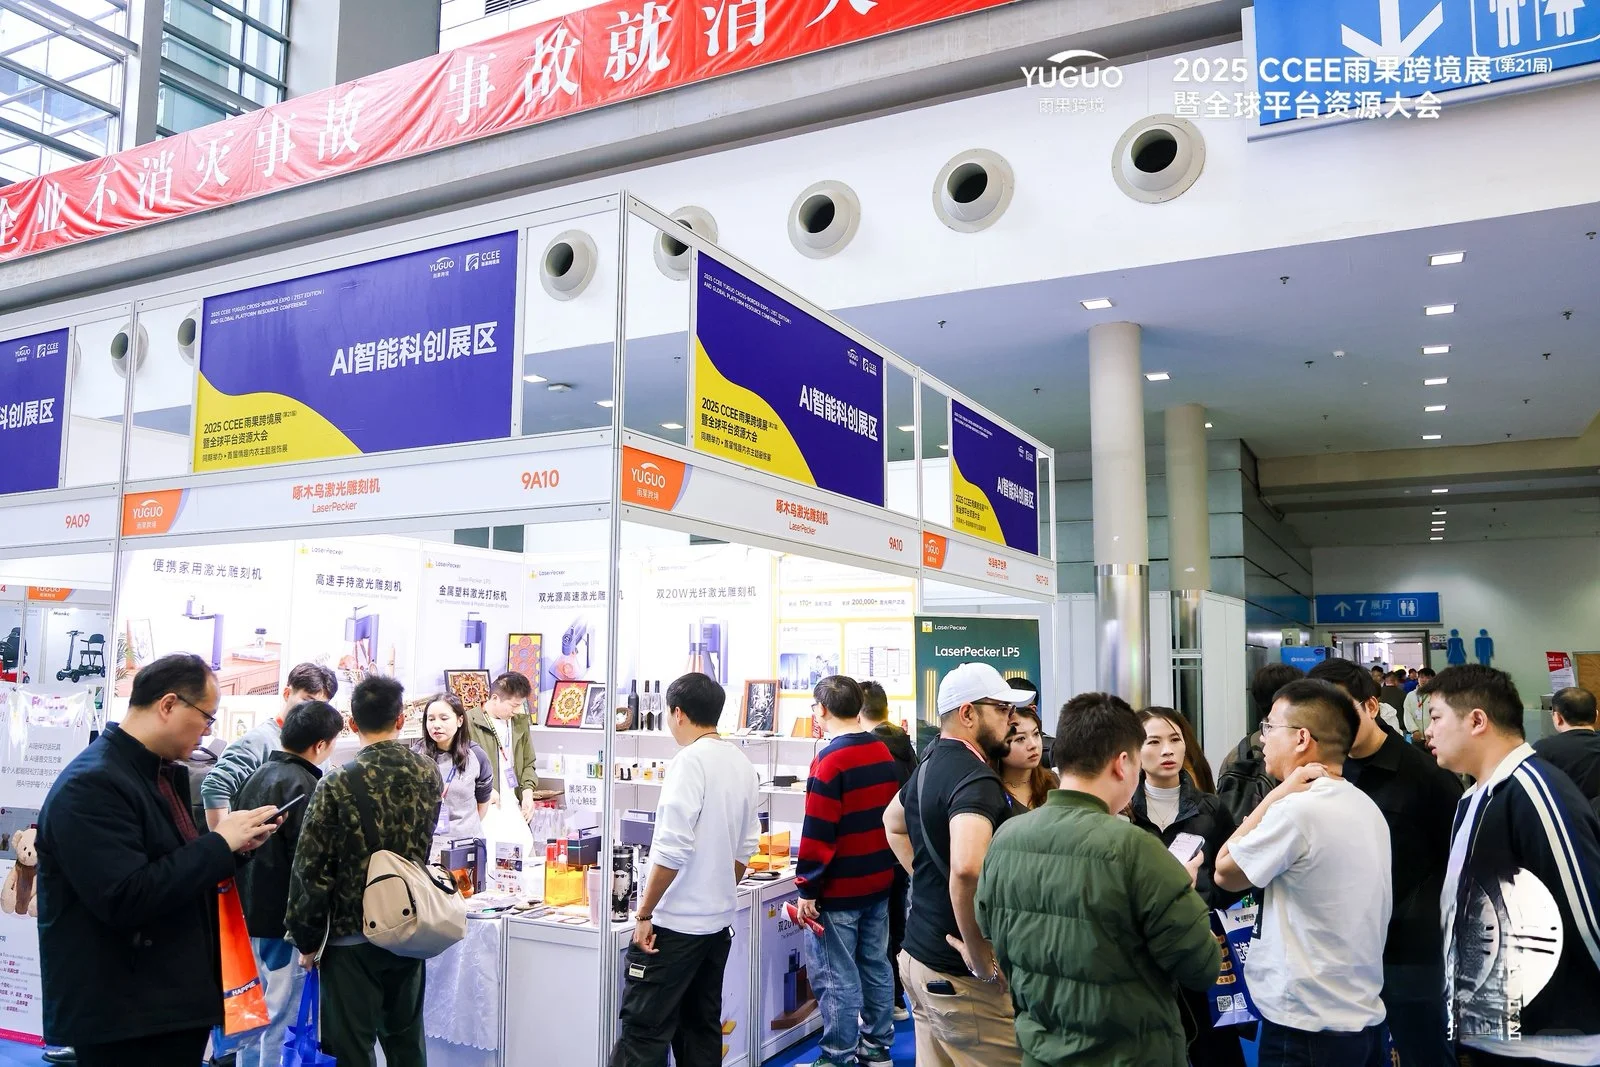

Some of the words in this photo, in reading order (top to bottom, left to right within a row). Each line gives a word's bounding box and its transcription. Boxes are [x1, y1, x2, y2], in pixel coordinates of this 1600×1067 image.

[481, 250, 500, 260] CCEE
[430, 260, 455, 272] YUGUO
[329, 321, 498, 377] AI智能科创展区
[702, 397, 719, 414] 2025
[799, 385, 878, 442] AI智能科创展区
[204, 421, 221, 434] 2025
[520, 469, 560, 490] 9A10
[631, 467, 666, 489] YUGUO
[292, 477, 380, 501] 啄木鸟激光雕刻机
[132, 506, 163, 519] YUGUO
[312, 501, 358, 514] LaserPecker
[776, 499, 829, 526] 啄木鸟激光雕刻机
[65, 513, 90, 530] 9A09
[789, 521, 817, 536] LaserPecker
[888, 536, 903, 552] 9A10
[153, 558, 262, 580] 便携家用激光雕刻机
[316, 573, 402, 592] 高速手持激光雕刻机
[439, 585, 508, 601] 金属塑料激光打标机
[656, 586, 757, 599] 双20W光纤激光雕刻机
[1355, 600, 1366, 616] 7
[935, 646, 1000, 657] LaserPecker
[1002, 647, 1020, 657] LP5
